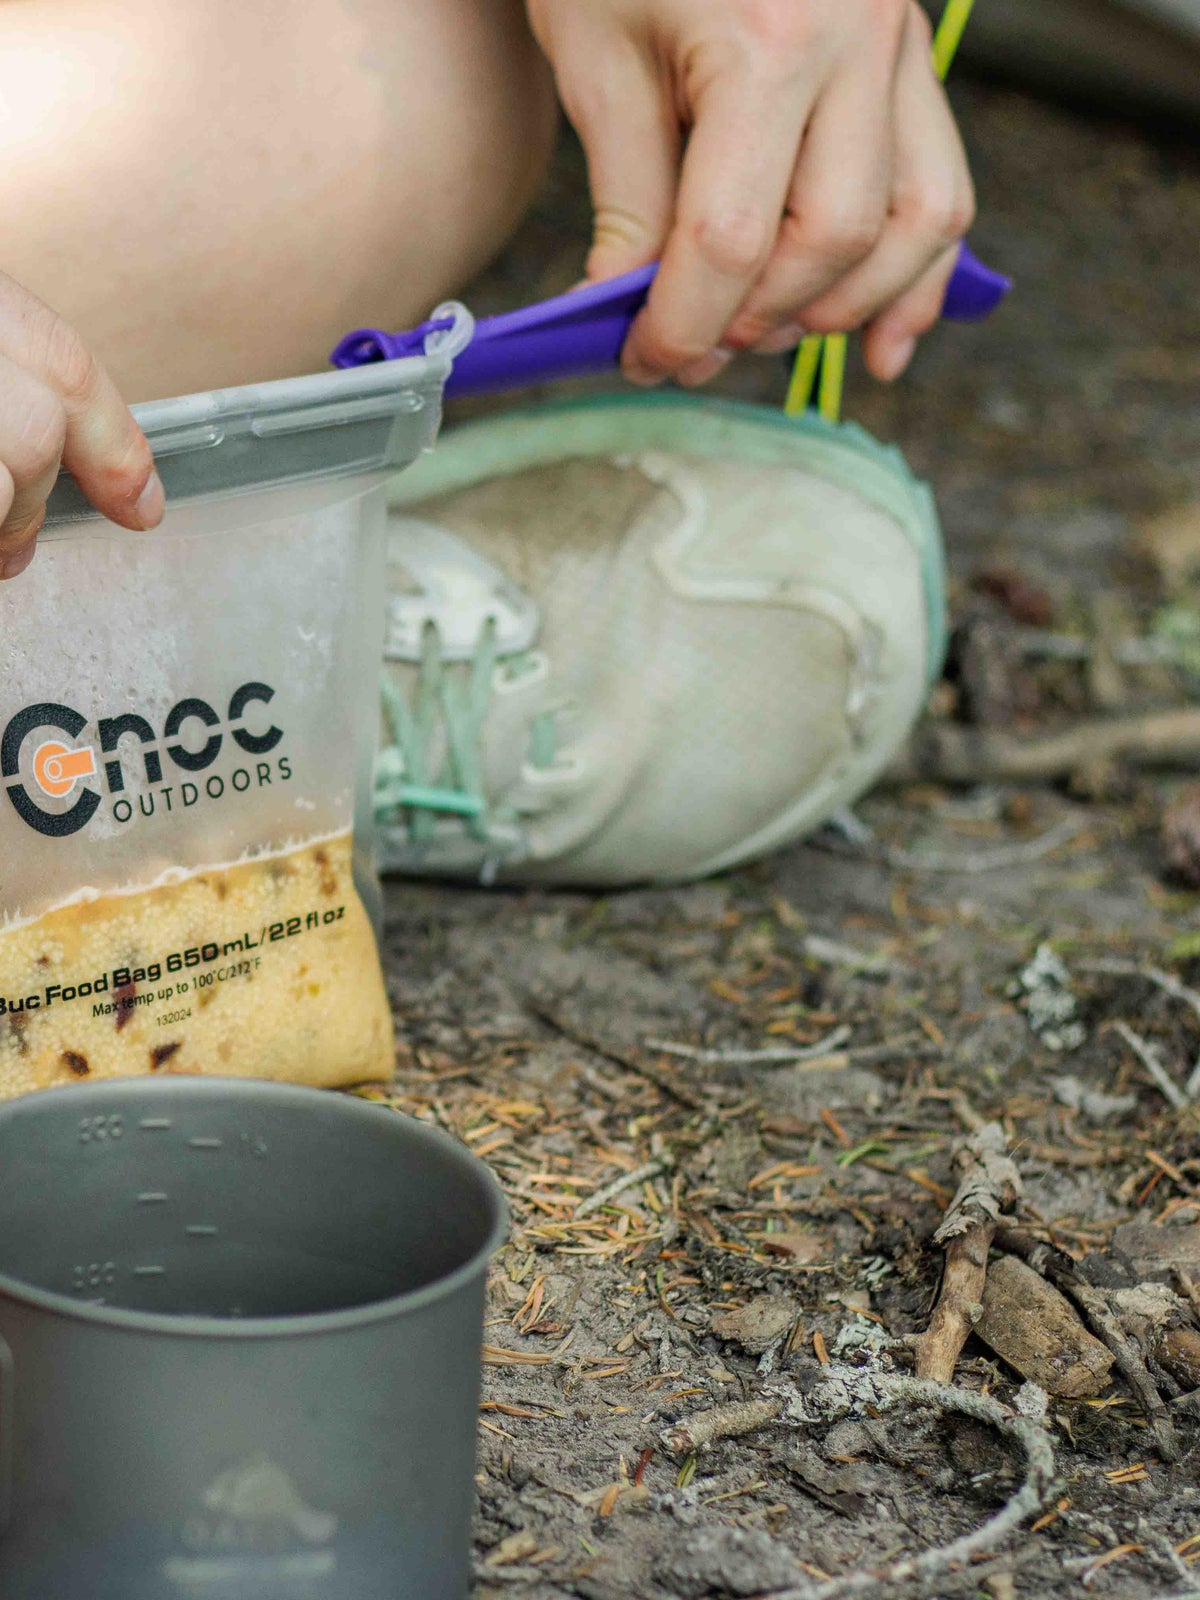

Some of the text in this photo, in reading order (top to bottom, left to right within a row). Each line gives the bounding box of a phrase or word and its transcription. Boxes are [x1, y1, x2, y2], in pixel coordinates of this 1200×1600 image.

[113, 757, 293, 823] OUTDOORS
[45, 973, 109, 1006] Food
[113, 963, 162, 989] Bag
[166, 942, 220, 973] 650
[306, 911, 319, 931] fl
[322, 906, 346, 925] oz
[92, 1003, 119, 1018] Max
[122, 991, 155, 1010] temp
[157, 986, 174, 1001] up
[176, 982, 189, 995] to
[156, 1007, 193, 1027] 132024
